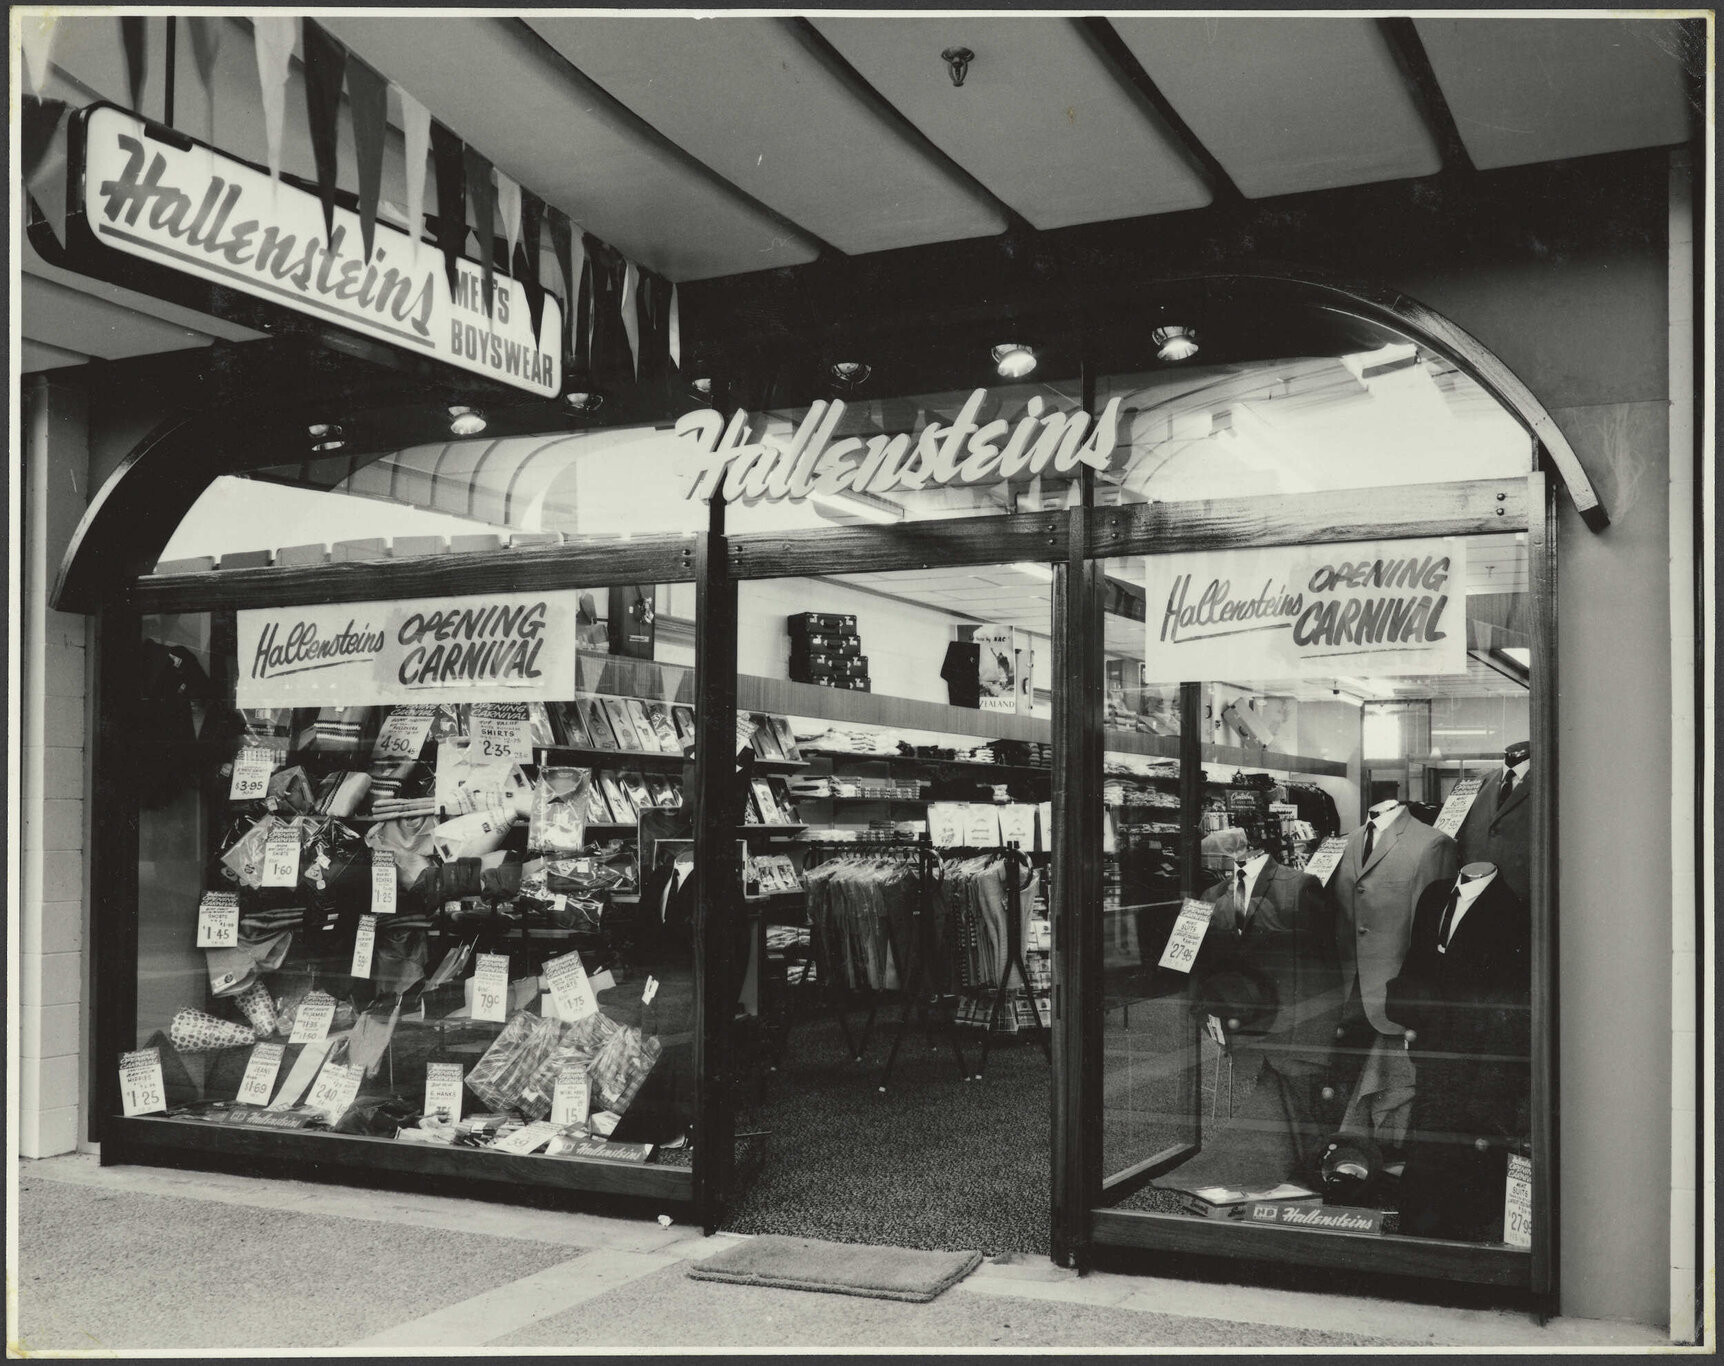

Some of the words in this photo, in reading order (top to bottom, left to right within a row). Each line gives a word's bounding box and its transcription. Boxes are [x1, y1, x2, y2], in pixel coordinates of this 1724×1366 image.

[100, 133, 434, 336] Hallensteins
[451, 318, 553, 389] BOYSWEAR
[675, 388, 1121, 501] Hallensteins
[1308, 556, 1450, 593] OPENING
[398, 602, 546, 646] OPENING
[1160, 574, 1303, 642] Hallensteins
[1293, 595, 1448, 646] CARNIVAL
[251, 619, 385, 679] Hallensteins
[398, 638, 544, 685] CARNIVAL
[471, 702, 527, 713] OPENING
[471, 709, 527, 720] CARNIVAL
[481, 728, 515, 737] SHIRTS
[1282, 1206, 1374, 1230] Hallensteins
